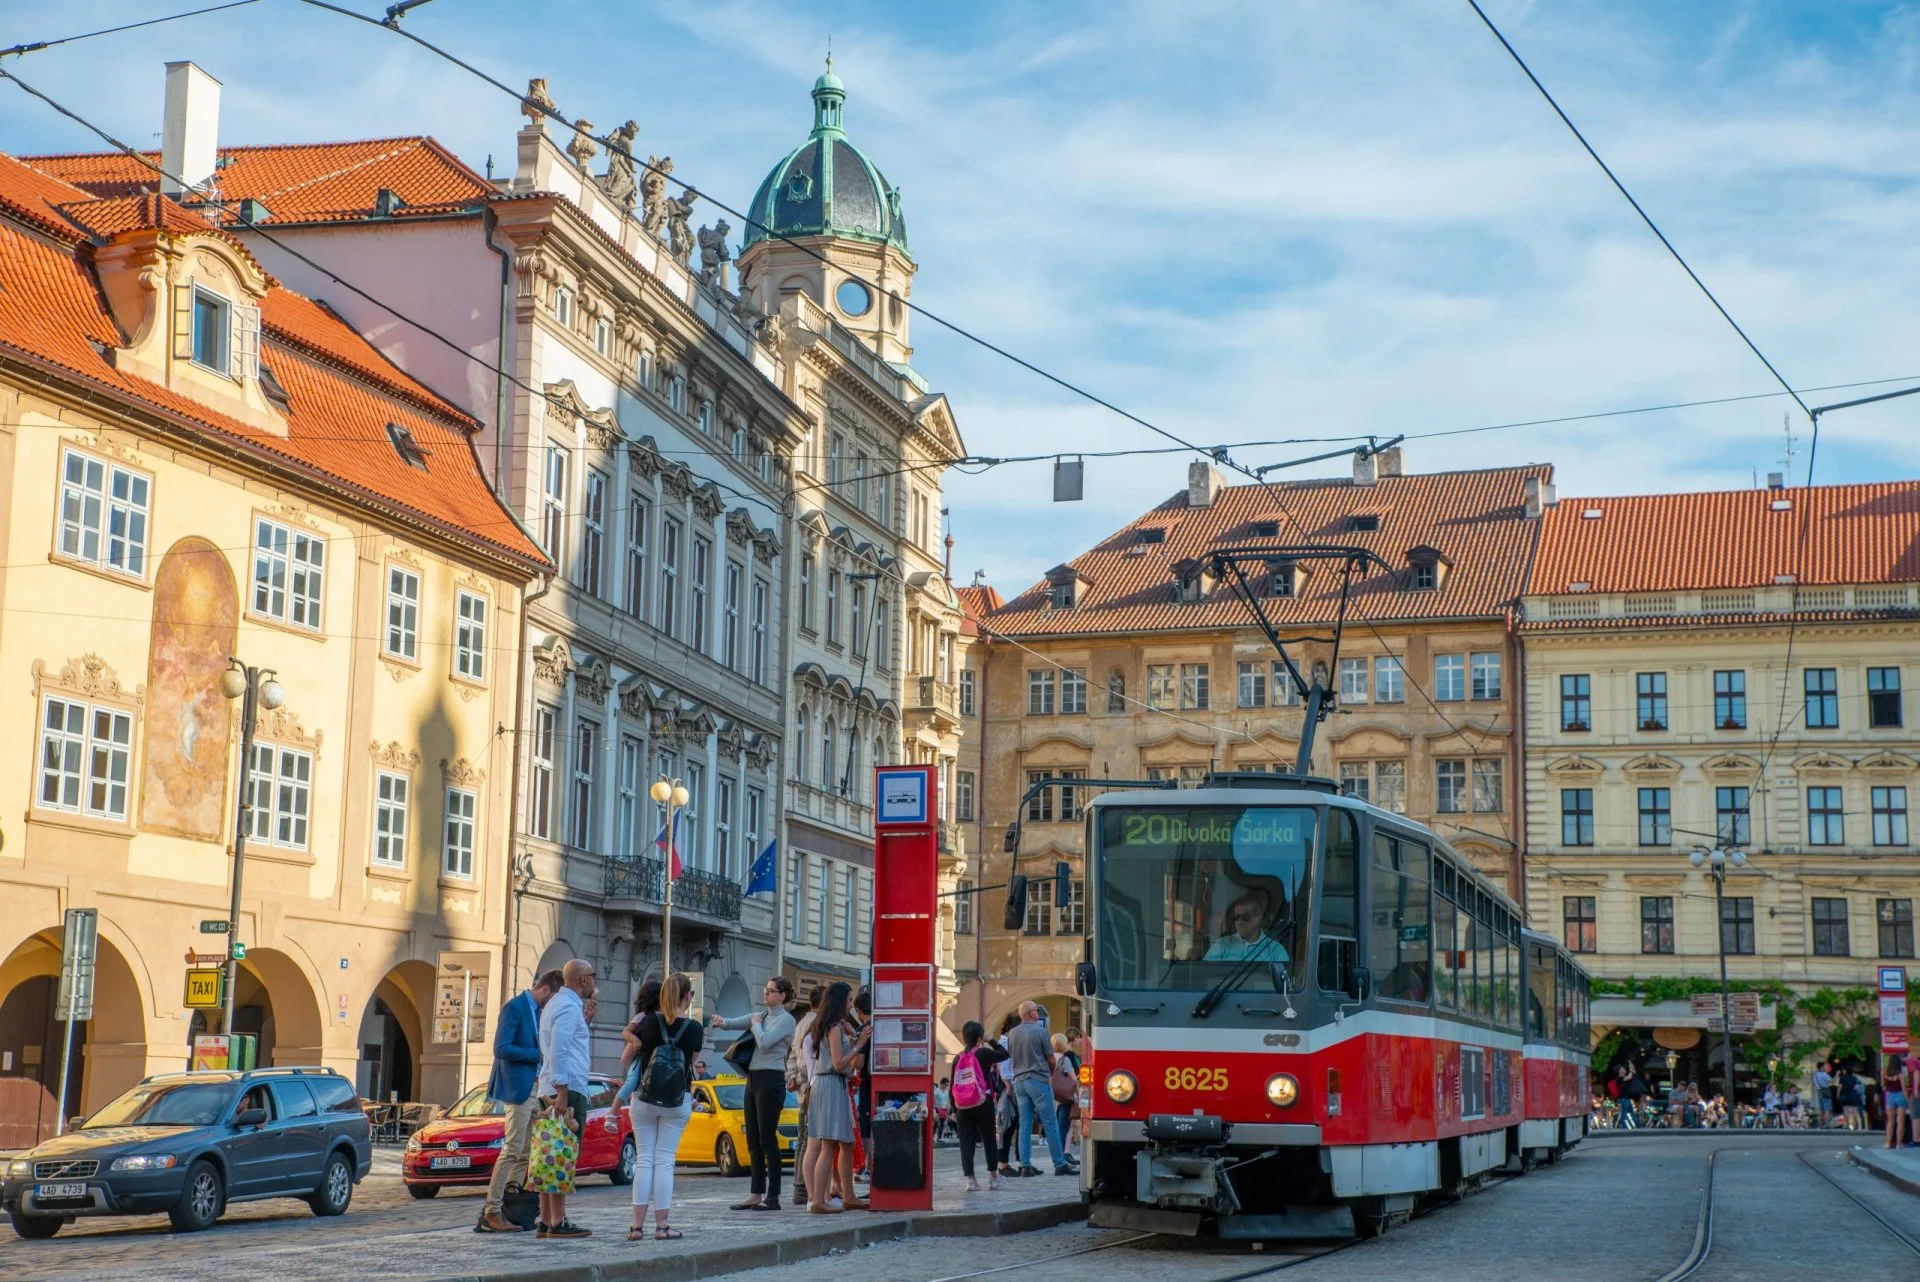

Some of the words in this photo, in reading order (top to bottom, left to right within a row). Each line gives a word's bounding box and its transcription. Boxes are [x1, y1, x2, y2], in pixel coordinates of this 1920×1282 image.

[1126, 814, 1167, 845] 20
[1170, 818, 1231, 843] Divoká
[1240, 813, 1293, 843] Šárka
[192, 981, 213, 995] TAXI
[1165, 1067, 1228, 1090] 8625
[41, 1185, 56, 1195] 4AD
[62, 1184, 82, 1195] 4739
